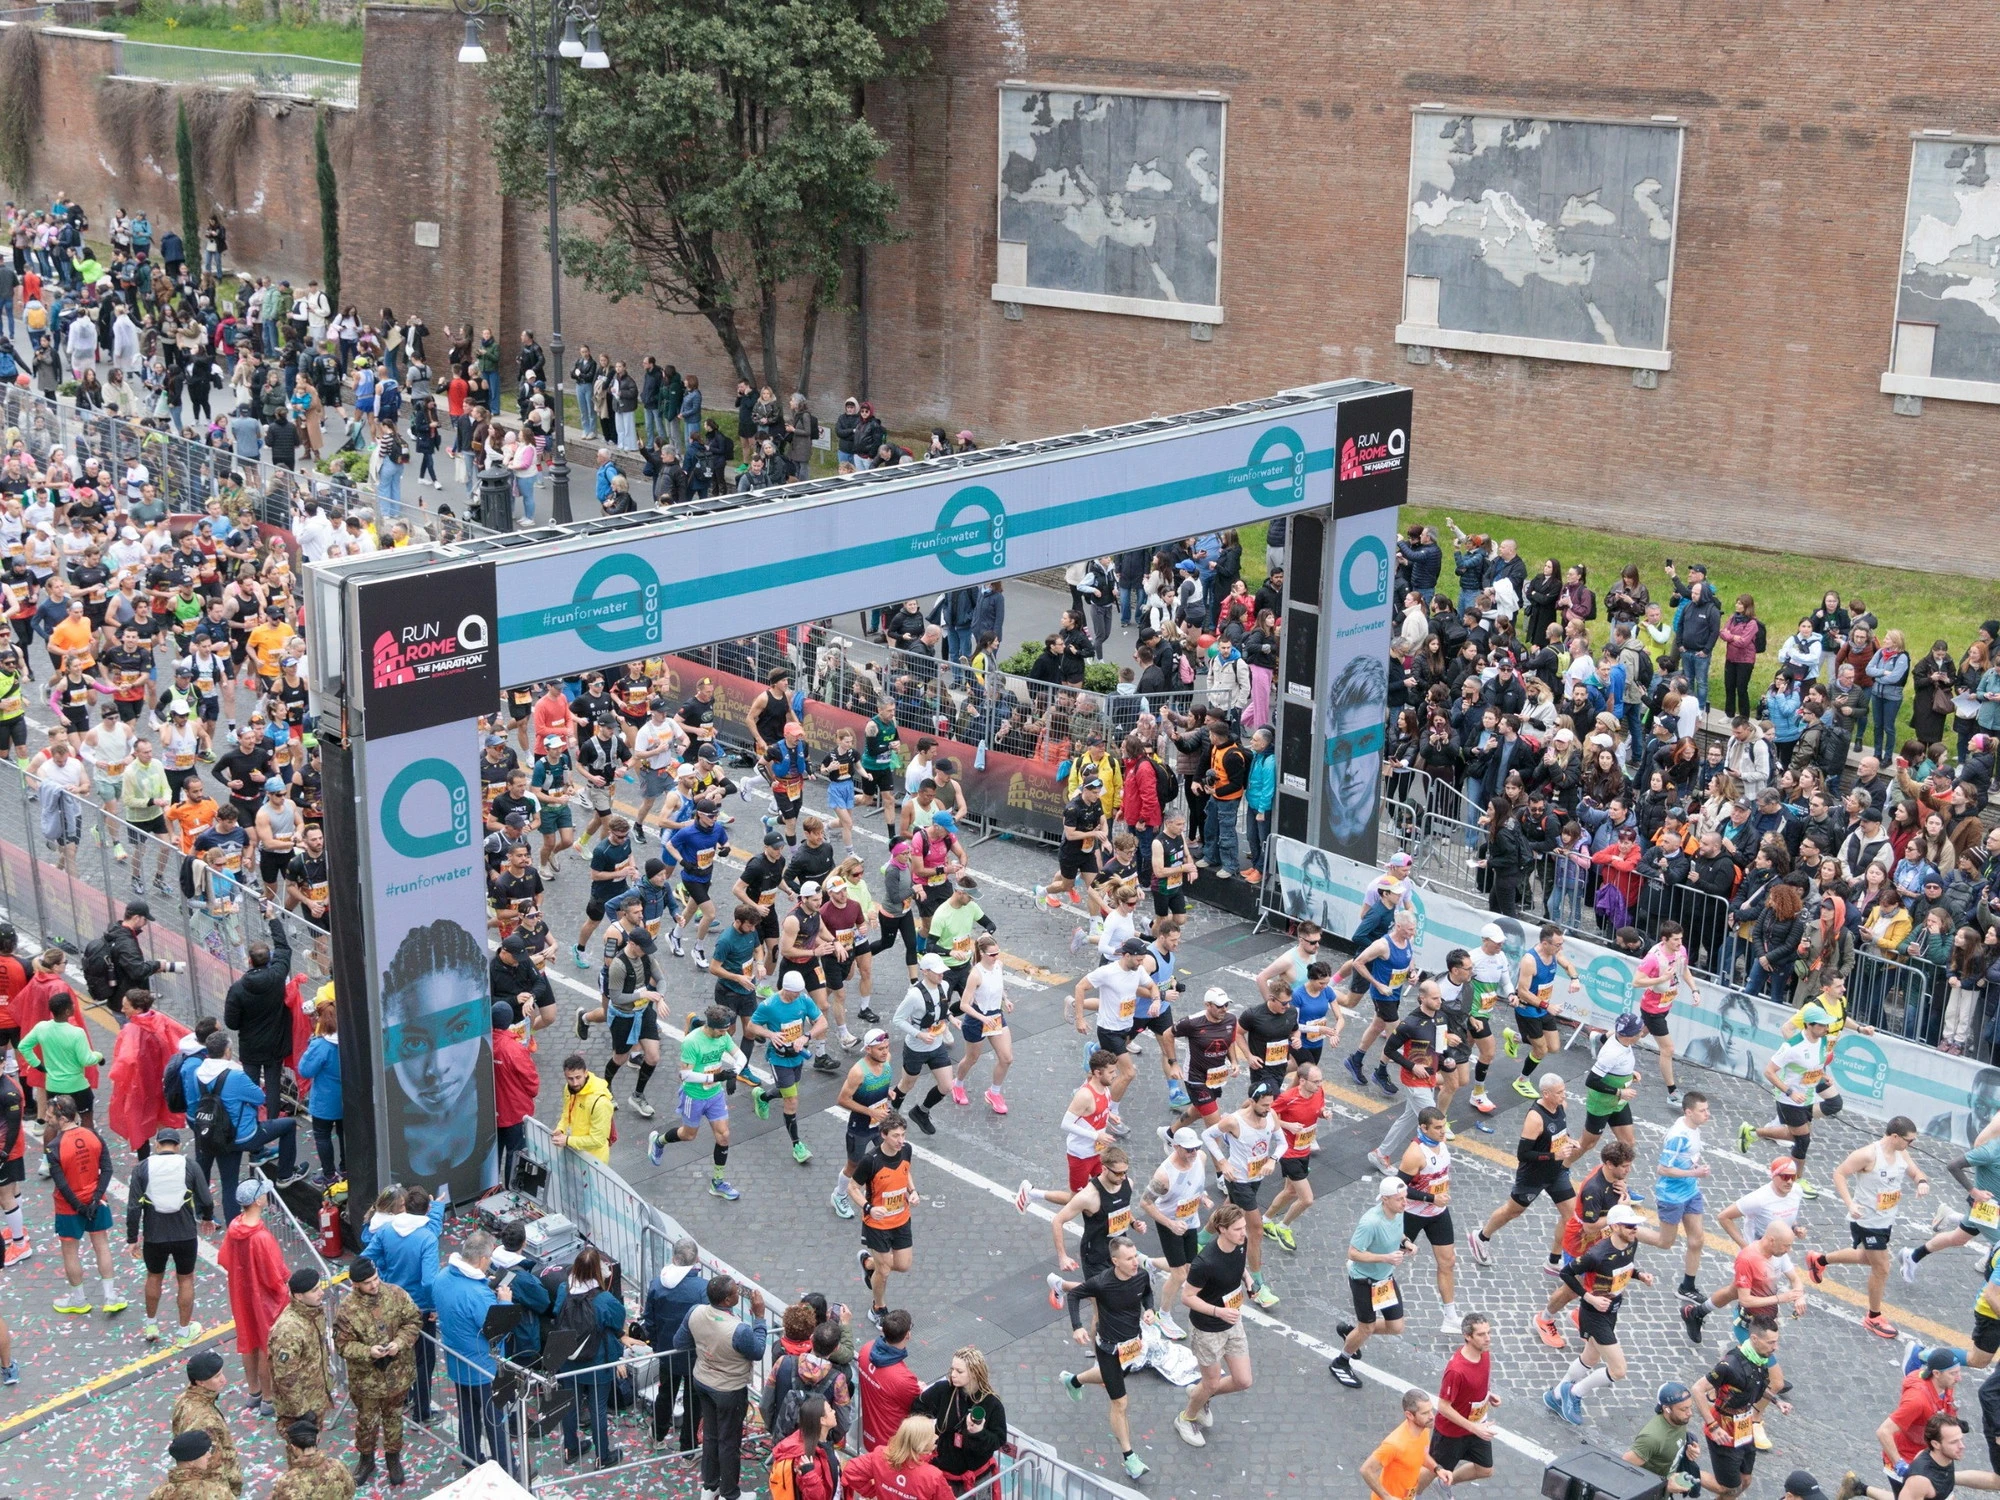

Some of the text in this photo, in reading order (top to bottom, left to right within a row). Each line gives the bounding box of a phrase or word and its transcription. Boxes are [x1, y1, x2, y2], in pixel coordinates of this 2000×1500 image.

[1357, 432, 1380, 448] RUN
[1359, 444, 1388, 461] ROME
[1227, 465, 1285, 485] #runforwater
[1293, 451, 1304, 499] acea
[1371, 459, 1401, 472] MARATHON
[910, 529, 980, 552] #runforwater
[992, 513, 1005, 566] acea
[1377, 558, 1388, 604] acea
[542, 600, 629, 627] #runforwater
[644, 583, 659, 641] acea
[402, 621, 440, 644] RUN
[1336, 619, 1386, 640] #runforwater
[405, 636, 457, 662] ROME
[417, 654, 483, 674] THE MARATHON
[1028, 774, 1052, 789] RUN
[1028, 787, 1062, 804] ROME
[452, 785, 468, 845] acea
[385, 865, 473, 898] #runforwater
[1414, 913, 1425, 945] acea
[1871, 1062, 1888, 1099] acea
